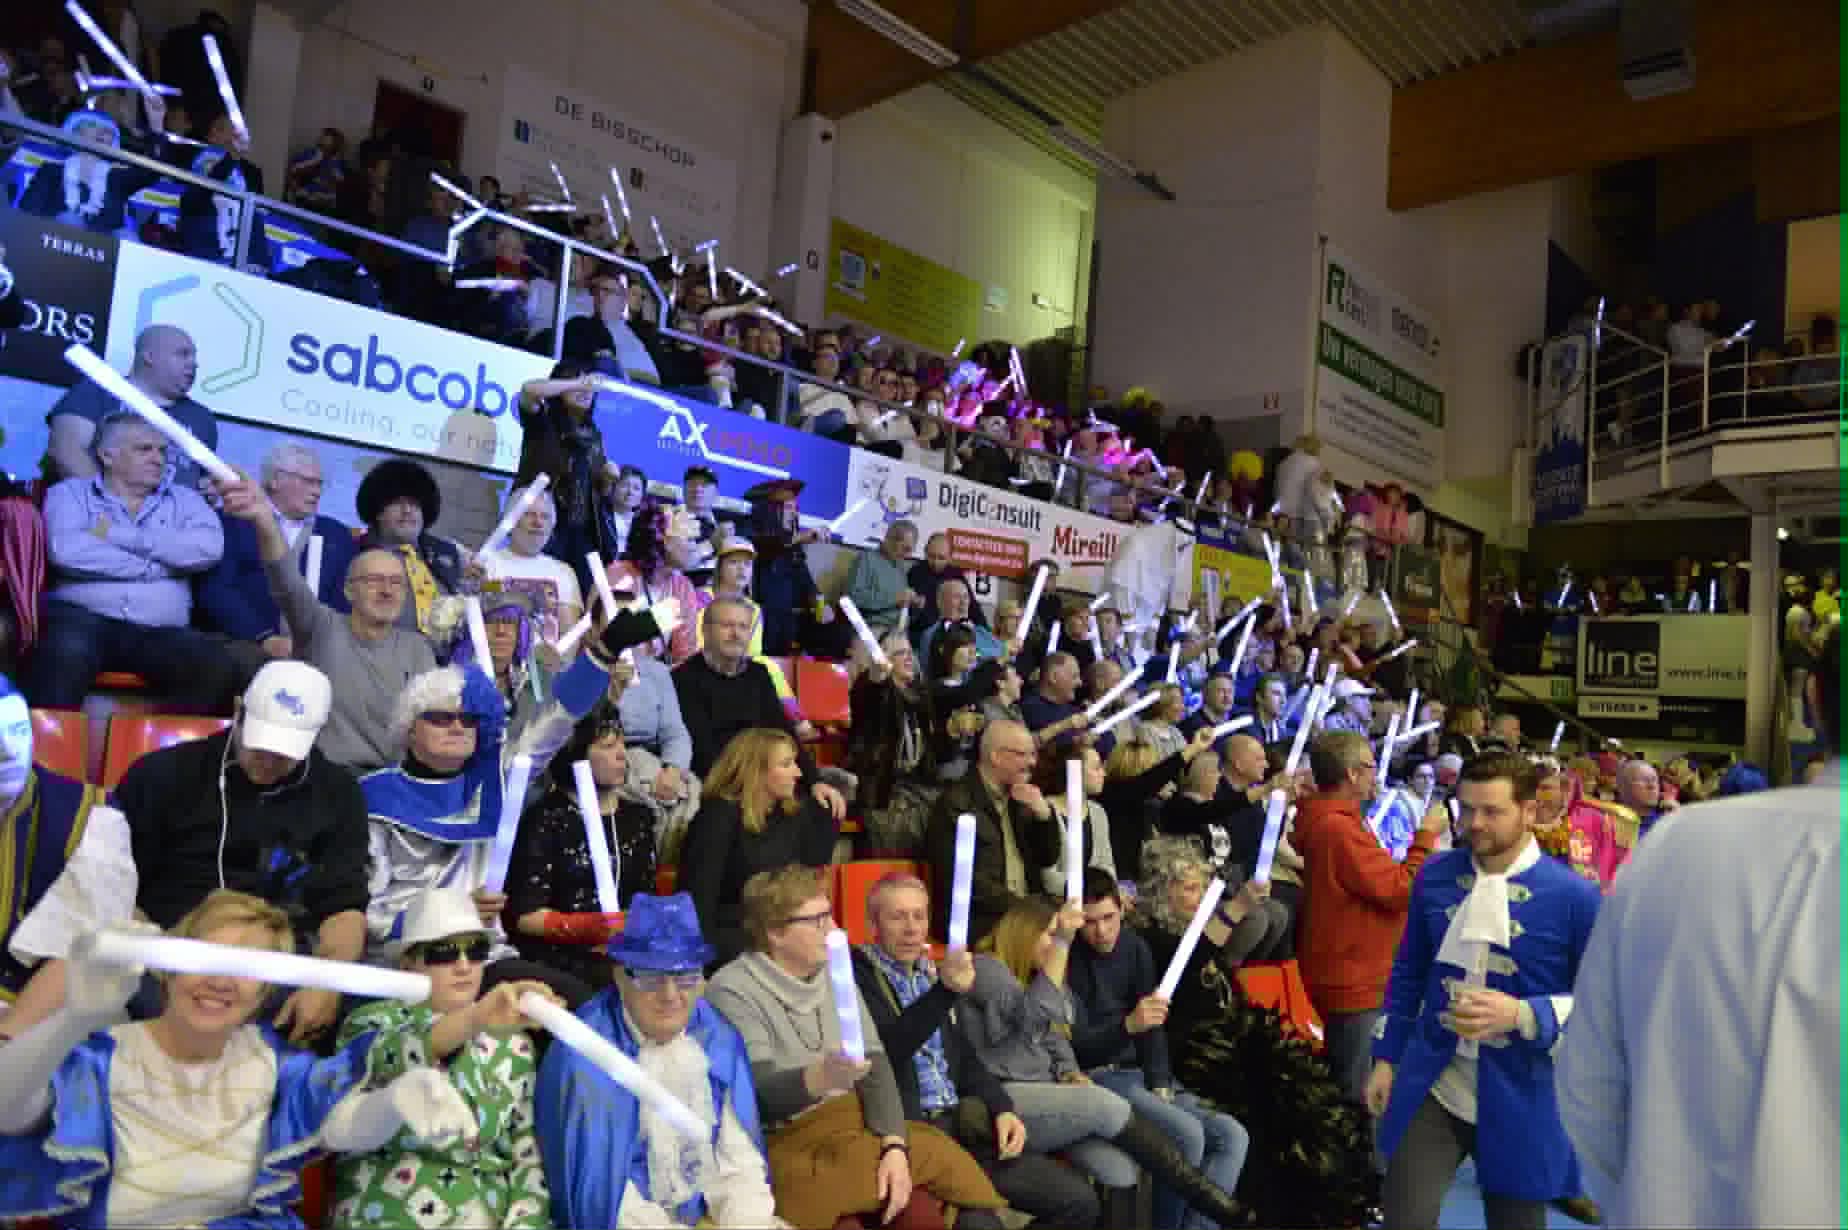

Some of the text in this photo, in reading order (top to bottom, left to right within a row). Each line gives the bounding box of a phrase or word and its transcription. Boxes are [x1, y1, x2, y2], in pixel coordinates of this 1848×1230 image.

[555, 95, 585, 121] DE
[41, 231, 105, 263] TERRAS
[18, 298, 95, 344] ORS
[1051, 523, 1119, 559] Mireill
